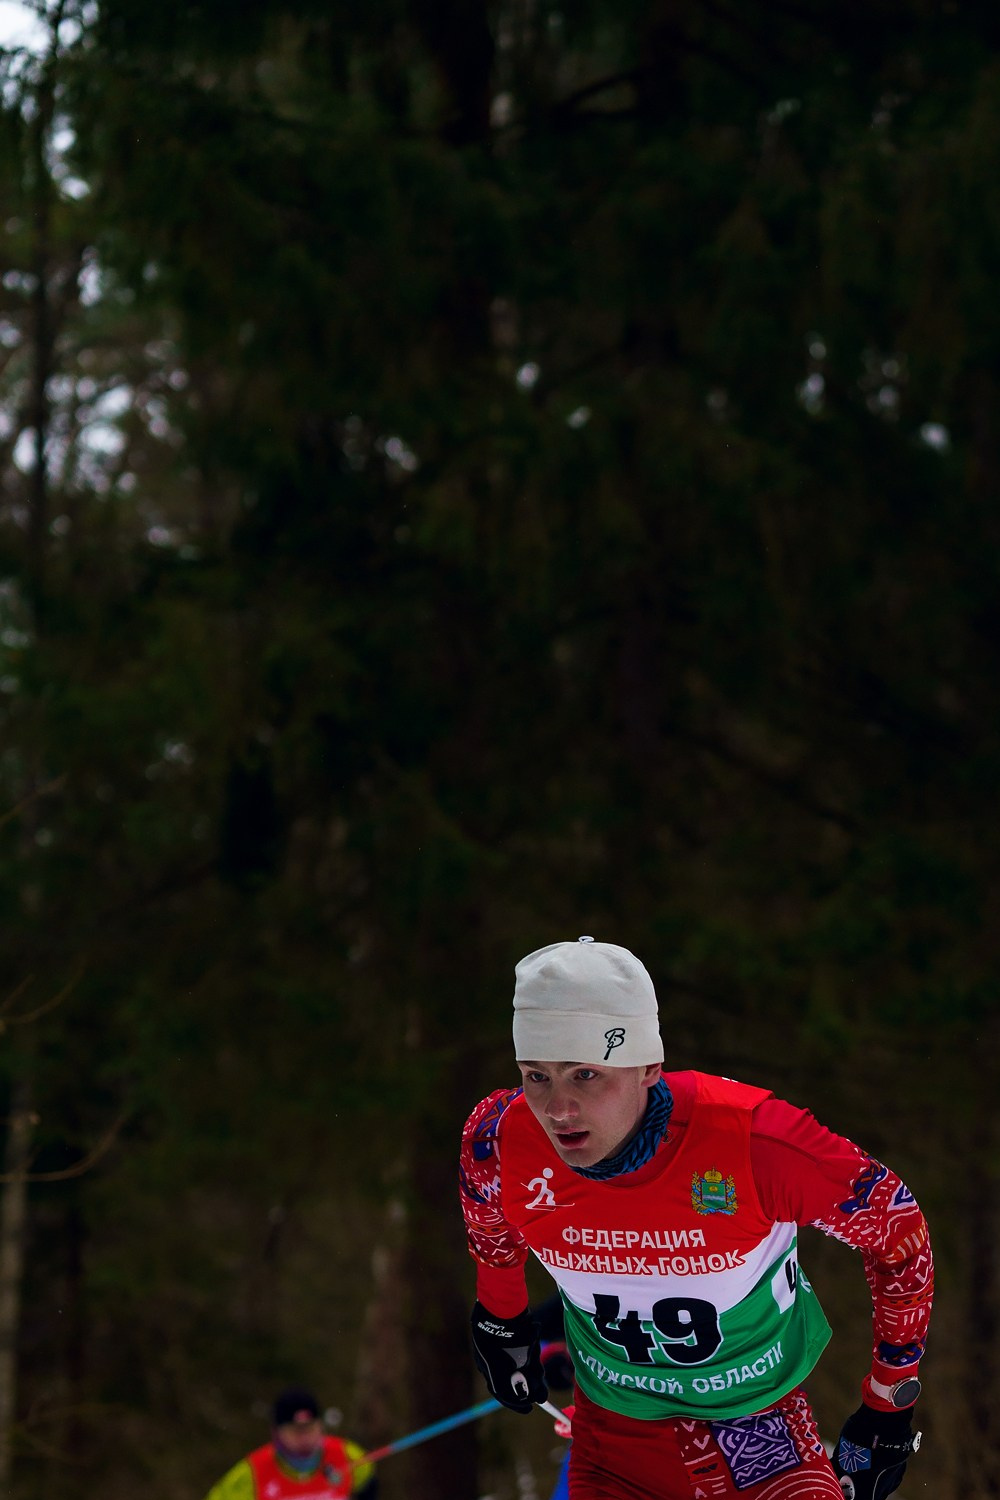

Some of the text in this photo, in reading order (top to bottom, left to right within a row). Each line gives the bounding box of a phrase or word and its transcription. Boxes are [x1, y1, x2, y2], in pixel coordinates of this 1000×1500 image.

[561, 1226, 706, 1252] ФЕДЕРАЦИЯ
[541, 1247, 745, 1275] ЛЫЖНЫХ ГОНОК
[591, 1293, 724, 1366] 49
[578, 1341, 784, 1394] ЛУЖСКОЙ ОБЛАСТИ
